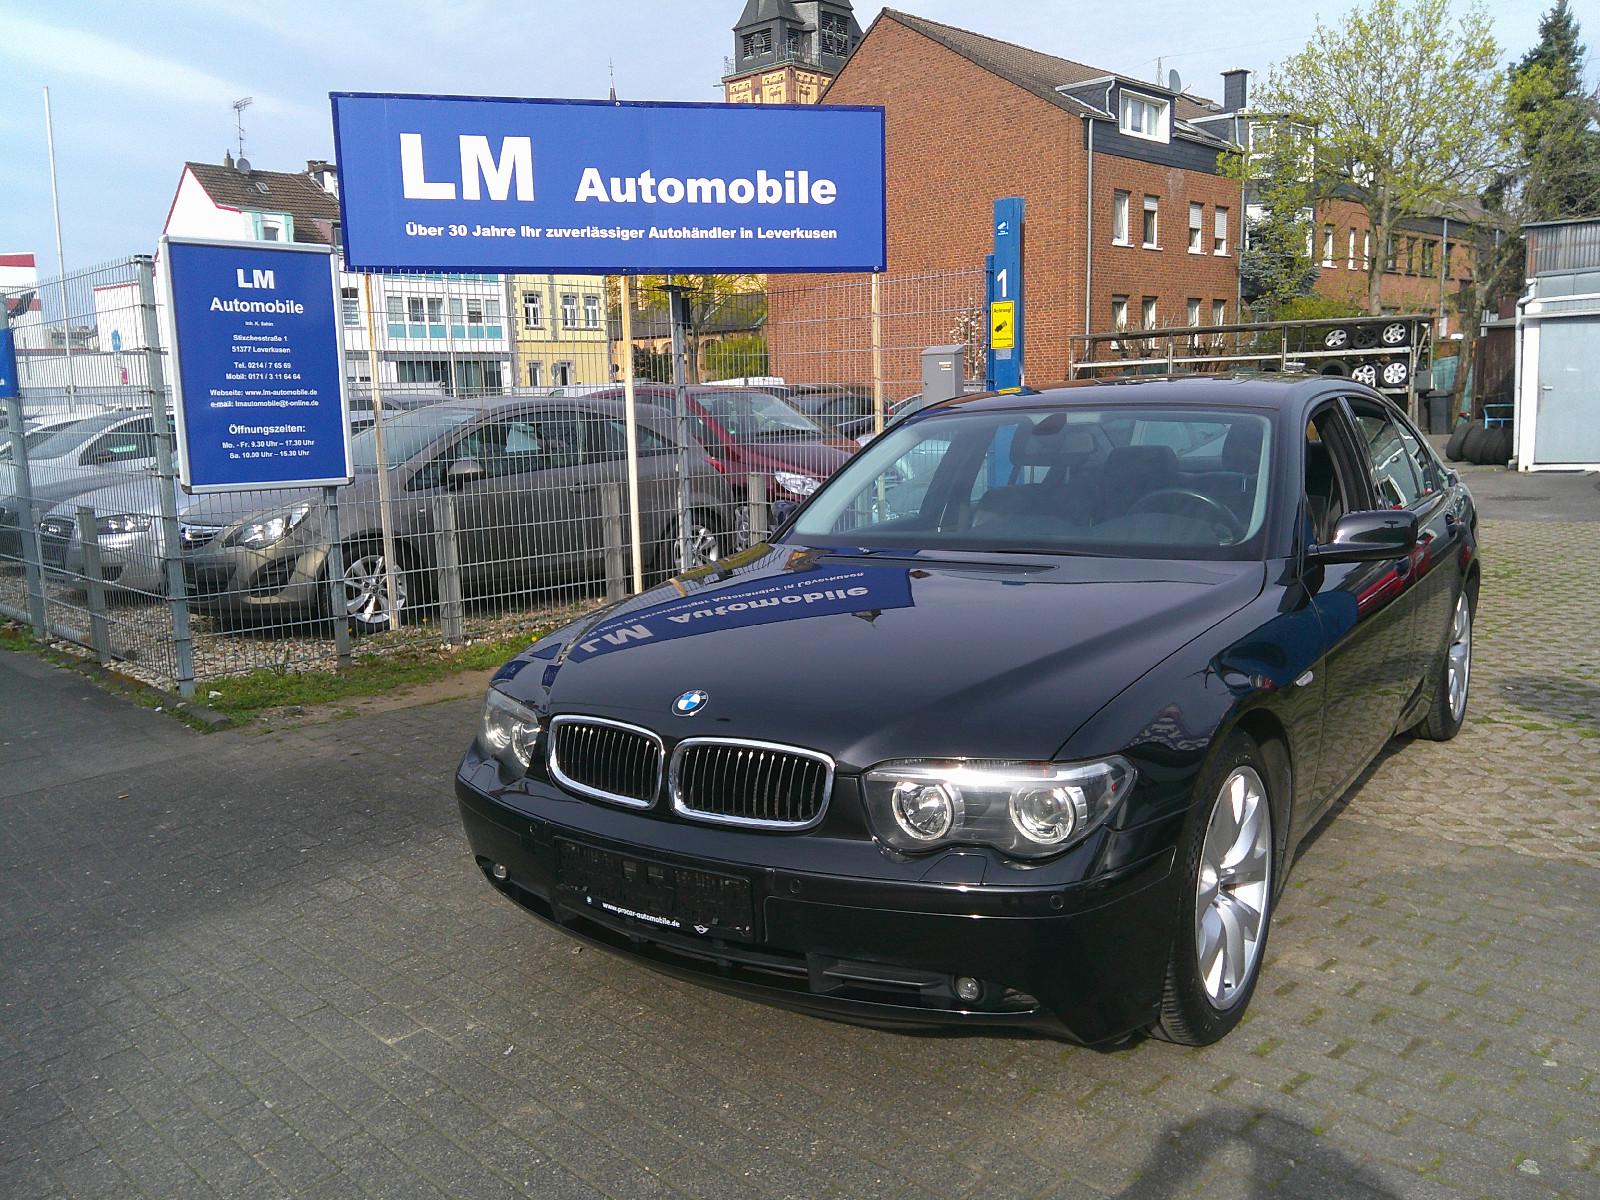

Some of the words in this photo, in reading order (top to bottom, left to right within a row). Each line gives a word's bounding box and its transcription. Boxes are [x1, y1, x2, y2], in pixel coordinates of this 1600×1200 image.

[400, 132, 535, 202] LM
[574, 167, 837, 205] Automobile
[405, 222, 445, 238] Über
[448, 224, 468, 237] 30
[472, 224, 517, 238] Jahre
[520, 225, 542, 238] Ihr
[545, 224, 646, 242] zuverlässiger
[648, 225, 737, 240] Autohändler
[740, 226, 754, 239] in
[757, 226, 838, 239] Leverkusen
[236, 268, 275, 289] LM
[996, 268, 1008, 298] 1
[210, 297, 304, 314] Automobile
[233, 361, 247, 369] Tel.
[244, 388, 318, 396] www.lm-automobile.de
[210, 400, 235, 408] e-mail:
[229, 424, 306, 435] Öffnungszeiten:
[222, 441, 236, 449] Mo.
[602, 902, 681, 928] www.procar-automobile.de
